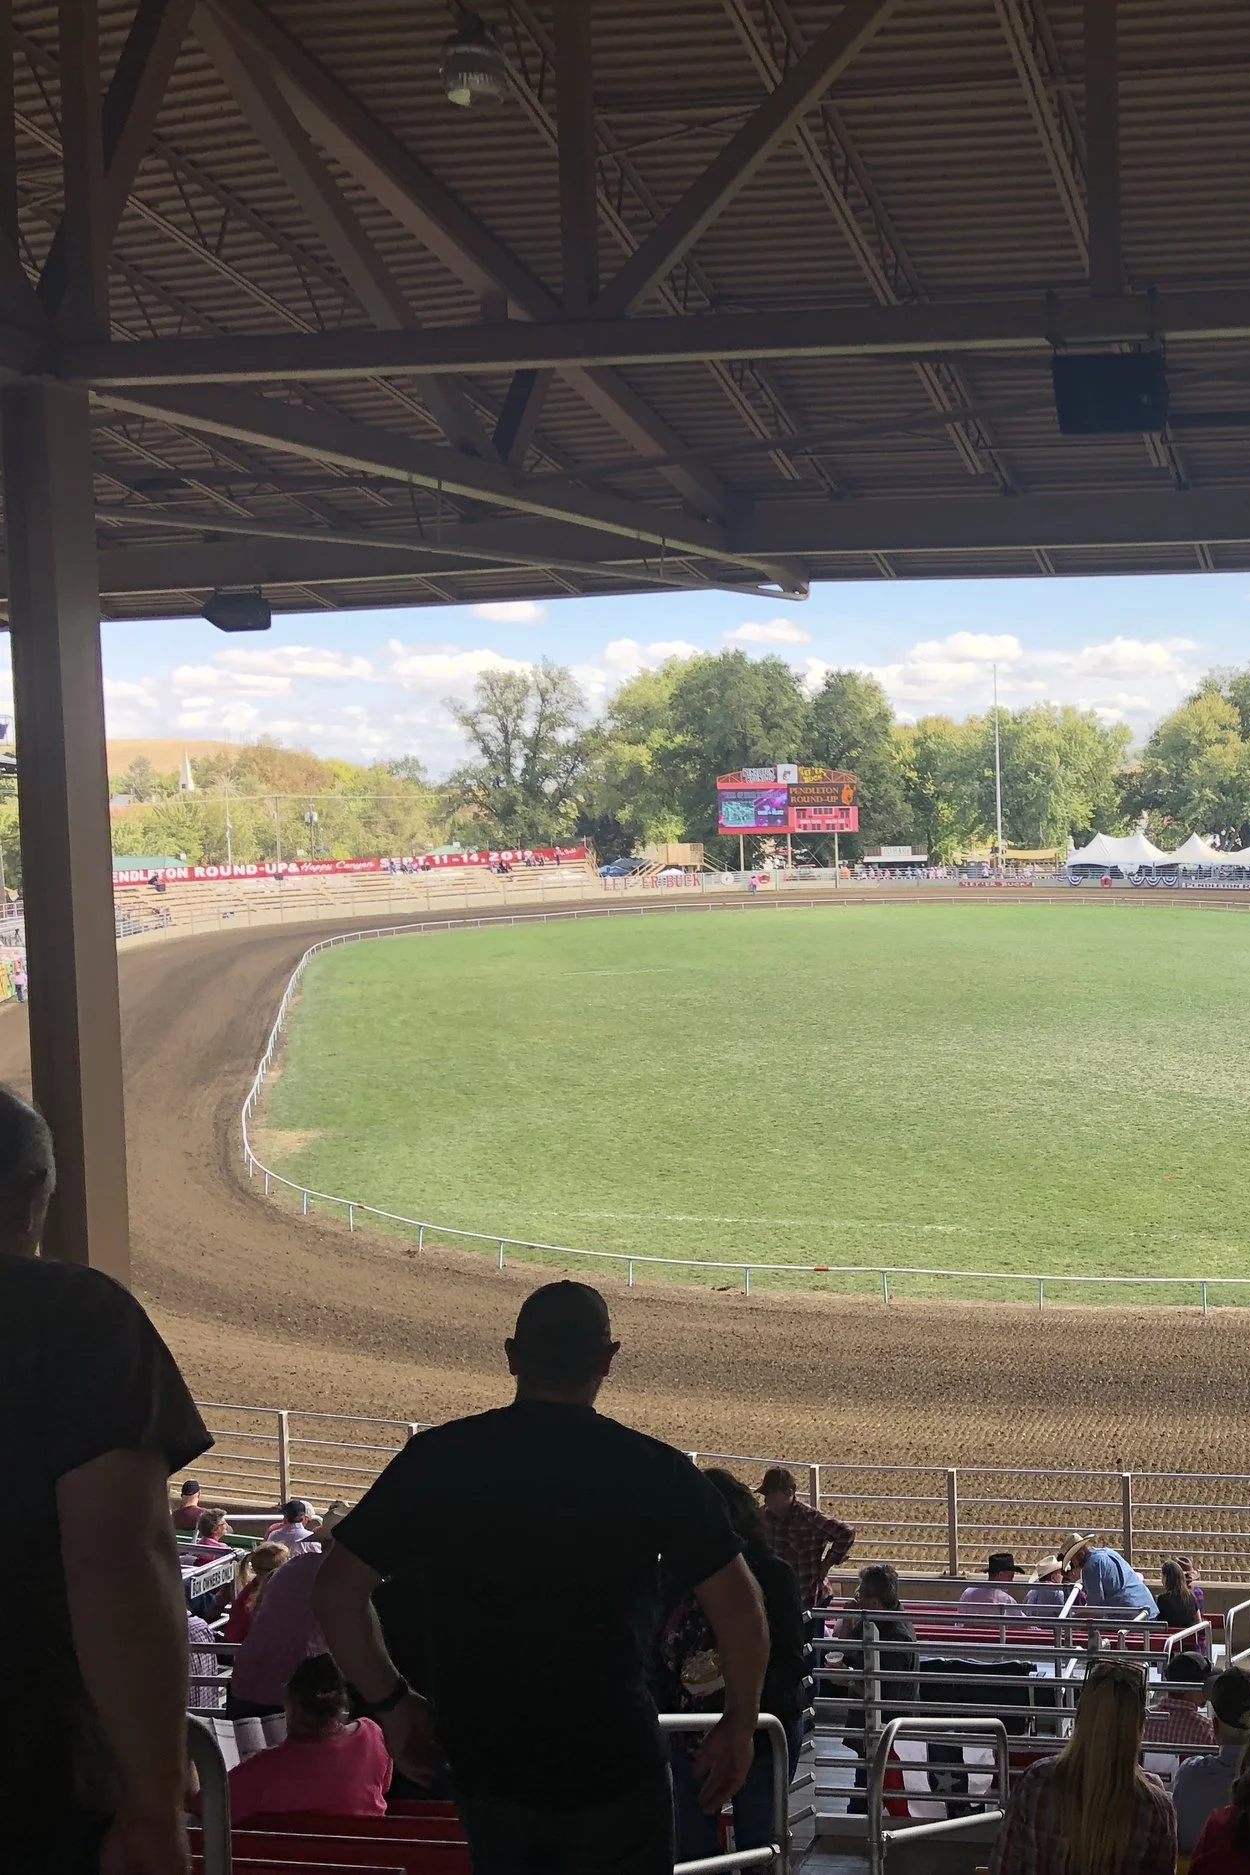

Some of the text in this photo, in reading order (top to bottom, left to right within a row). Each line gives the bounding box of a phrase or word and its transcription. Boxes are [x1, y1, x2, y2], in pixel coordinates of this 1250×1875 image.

[113, 867, 188, 882] ENDLETON
[300, 862, 332, 873] Happy
[336, 860, 374, 870] Canyon
[666, 873, 700, 887] BUCK
[193, 1566, 233, 1597] BOX OWNERS ONLY
